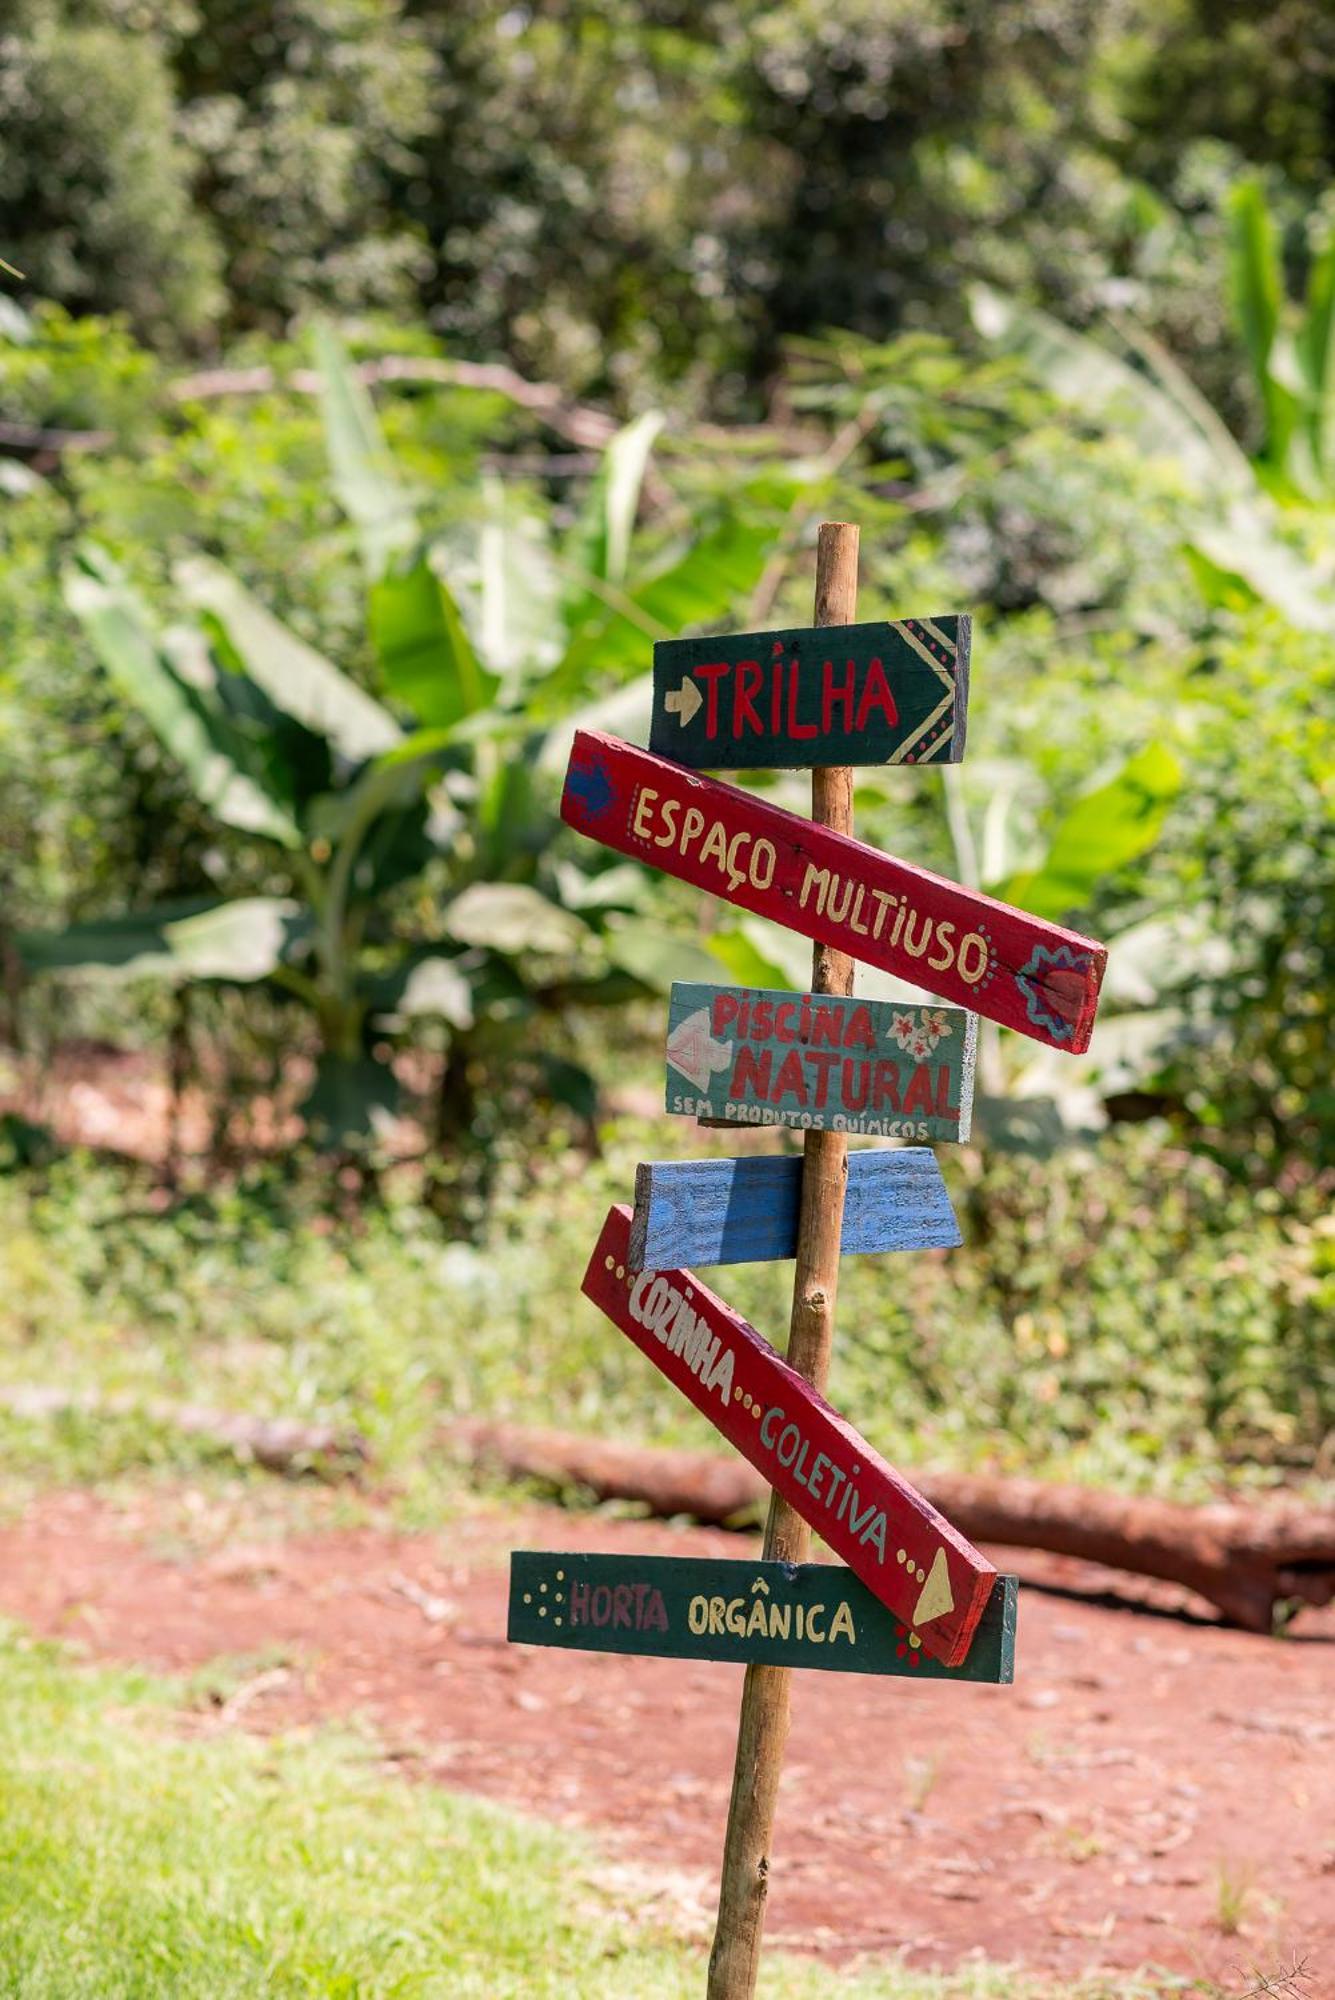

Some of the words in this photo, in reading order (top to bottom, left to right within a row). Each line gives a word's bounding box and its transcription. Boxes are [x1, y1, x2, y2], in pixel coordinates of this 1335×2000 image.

[633, 788, 777, 891] ESPAÇO
[799, 862, 988, 985] MULTIUSO
[673, 1095, 713, 1117] SEM
[725, 1103, 825, 1131] PRODUTOS
[729, 1045, 961, 1121] NATURAL
[569, 1581, 669, 1633] HORTA
[688, 1576, 857, 1645] ORGÂNICA
